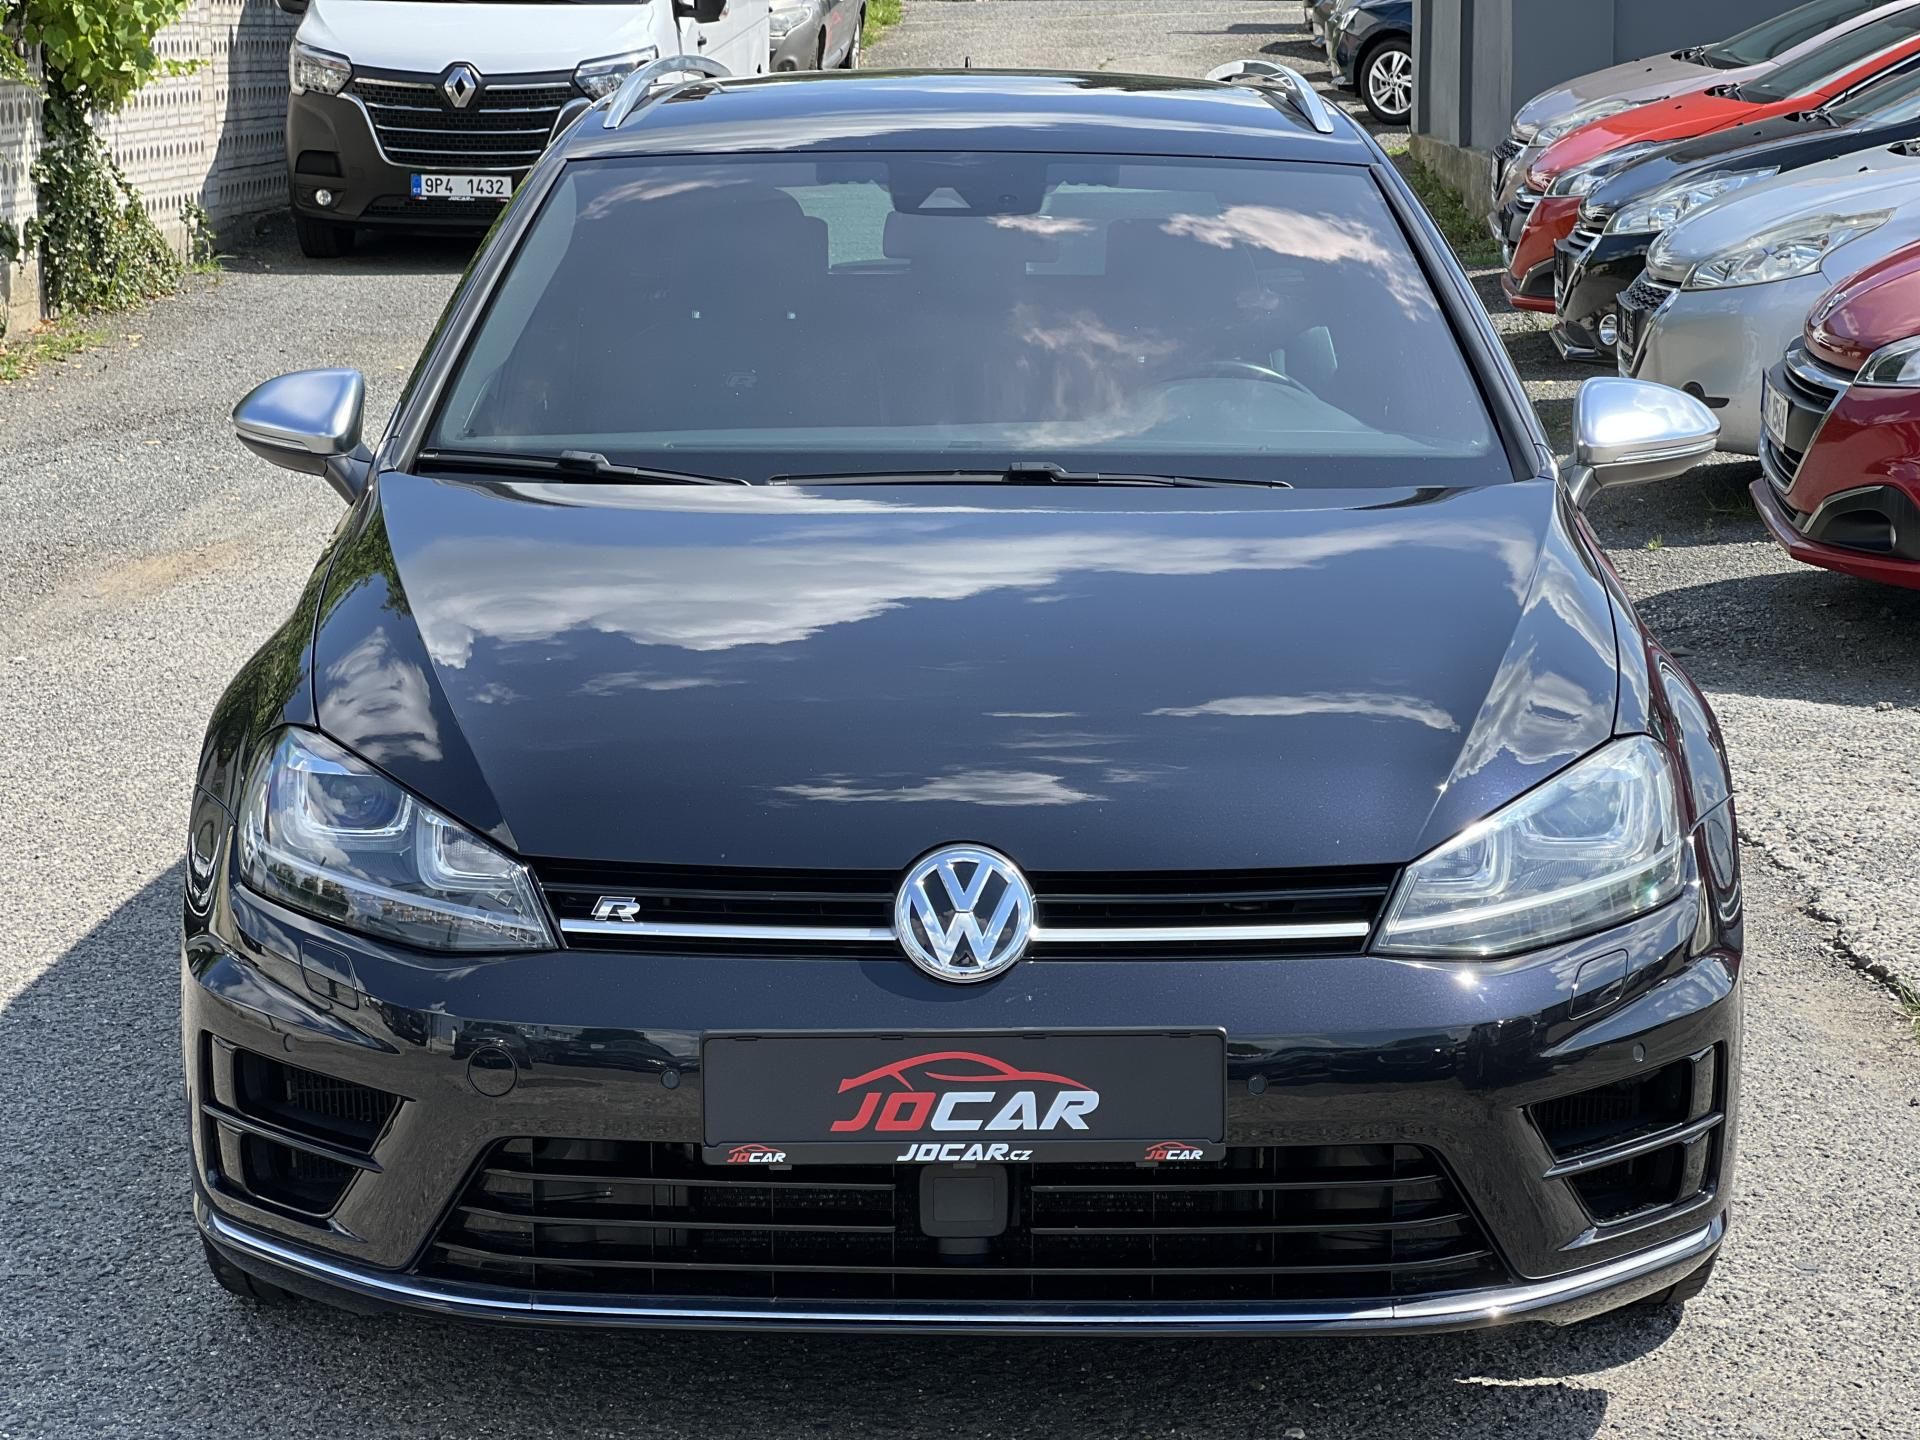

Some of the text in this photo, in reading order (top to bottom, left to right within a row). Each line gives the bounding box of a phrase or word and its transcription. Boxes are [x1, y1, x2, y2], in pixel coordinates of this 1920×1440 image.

[425, 178, 504, 194] 9P4 1432
[591, 896, 640, 922] R
[830, 1091, 1100, 1131] JOCAR
[727, 1151, 786, 1163] JOCAR
[896, 1143, 1033, 1161] JOCAR.cz
[1144, 1149, 1203, 1160] JOCAR
